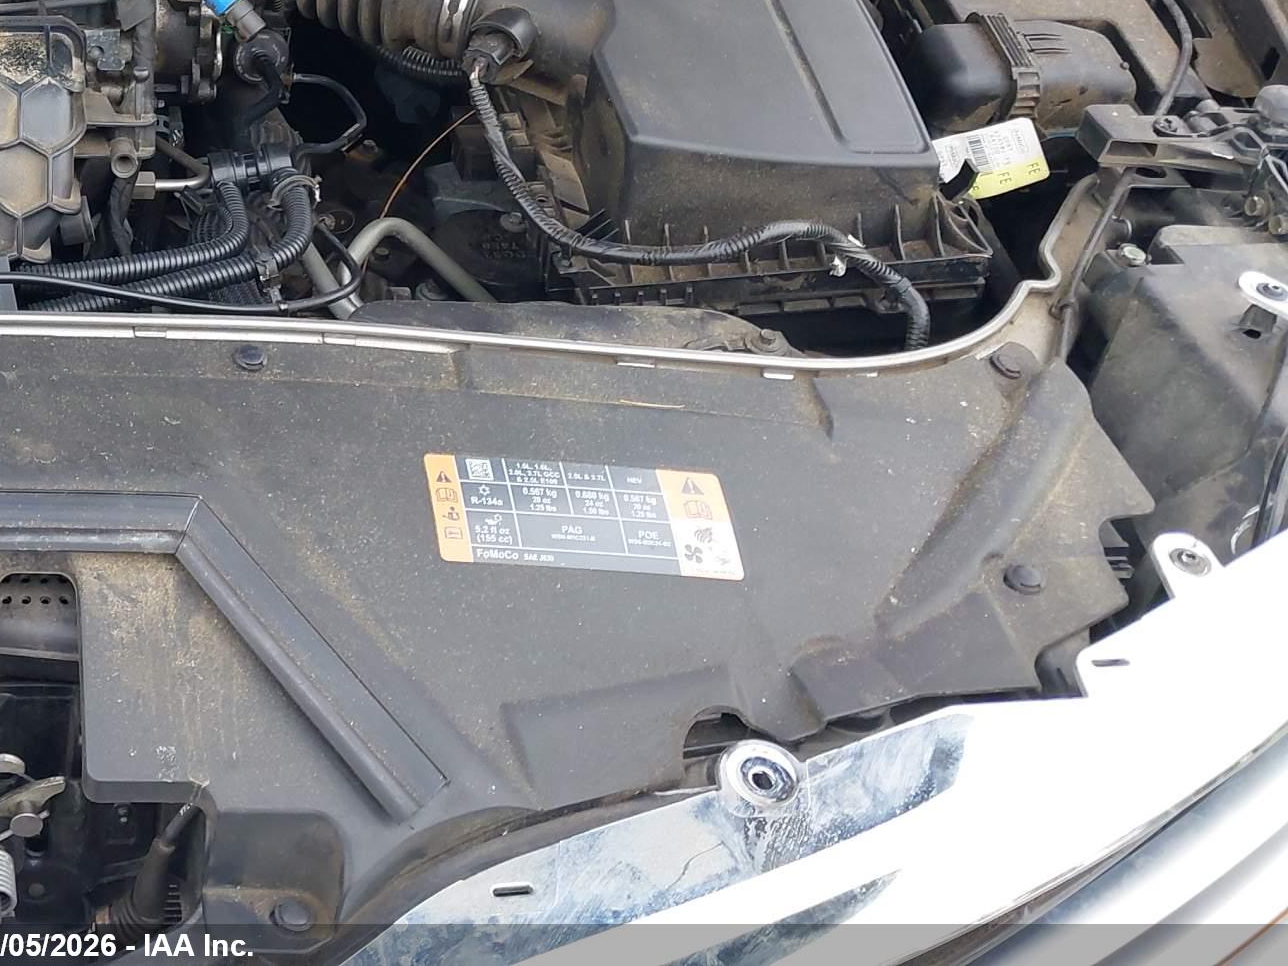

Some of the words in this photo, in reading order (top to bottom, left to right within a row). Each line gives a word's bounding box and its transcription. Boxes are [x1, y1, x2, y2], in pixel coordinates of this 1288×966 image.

[1025, 162, 1041, 176] FE
[997, 171, 1013, 185] FE
[545, 488, 558, 499] kg
[470, 497, 504, 506] R-134a
[499, 527, 510, 535] oz
[562, 525, 583, 535] PAG
[638, 530, 660, 540] POE
[476, 550, 519, 561] FoMoCo
